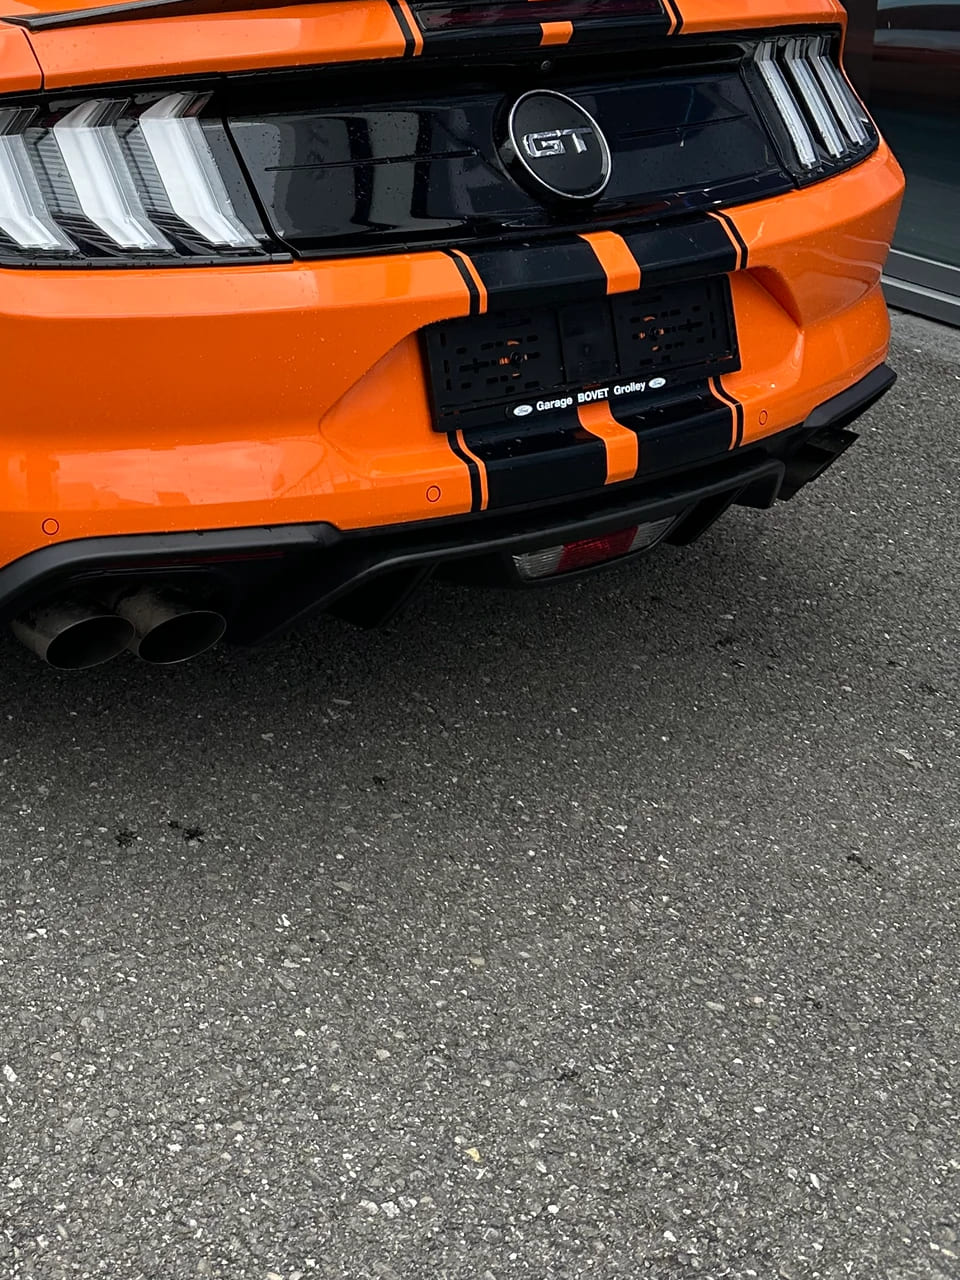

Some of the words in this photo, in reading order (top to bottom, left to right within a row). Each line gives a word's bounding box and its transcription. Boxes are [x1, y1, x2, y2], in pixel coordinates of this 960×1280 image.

[522, 127, 593, 158] GT
[536, 396, 573, 412] Garage
[577, 387, 610, 403] BOVET
[613, 381, 646, 396] Grolley
